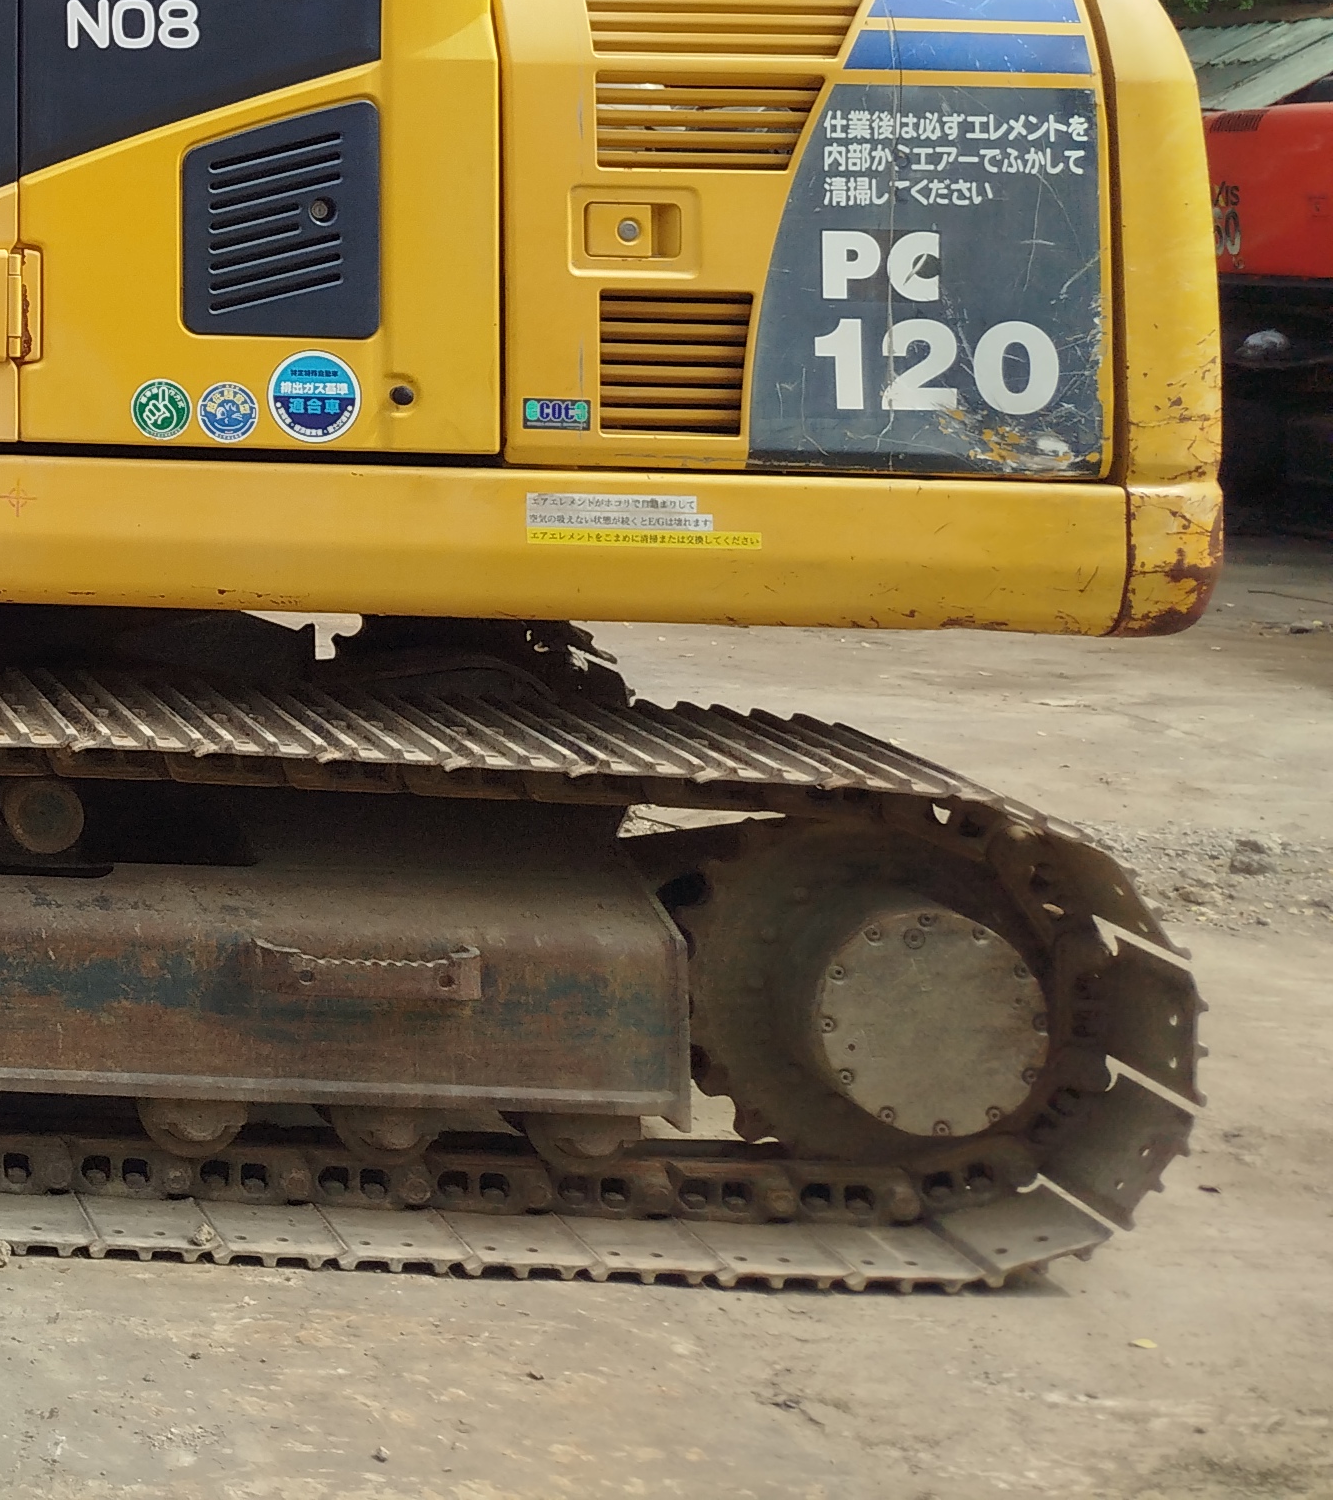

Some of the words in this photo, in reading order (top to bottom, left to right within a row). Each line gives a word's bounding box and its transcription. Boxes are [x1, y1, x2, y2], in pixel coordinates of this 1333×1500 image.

[823, 110, 1089, 143] 仕業後は必ずエレメントを
[821, 230, 941, 302] PC
[814, 318, 1061, 415] 120
